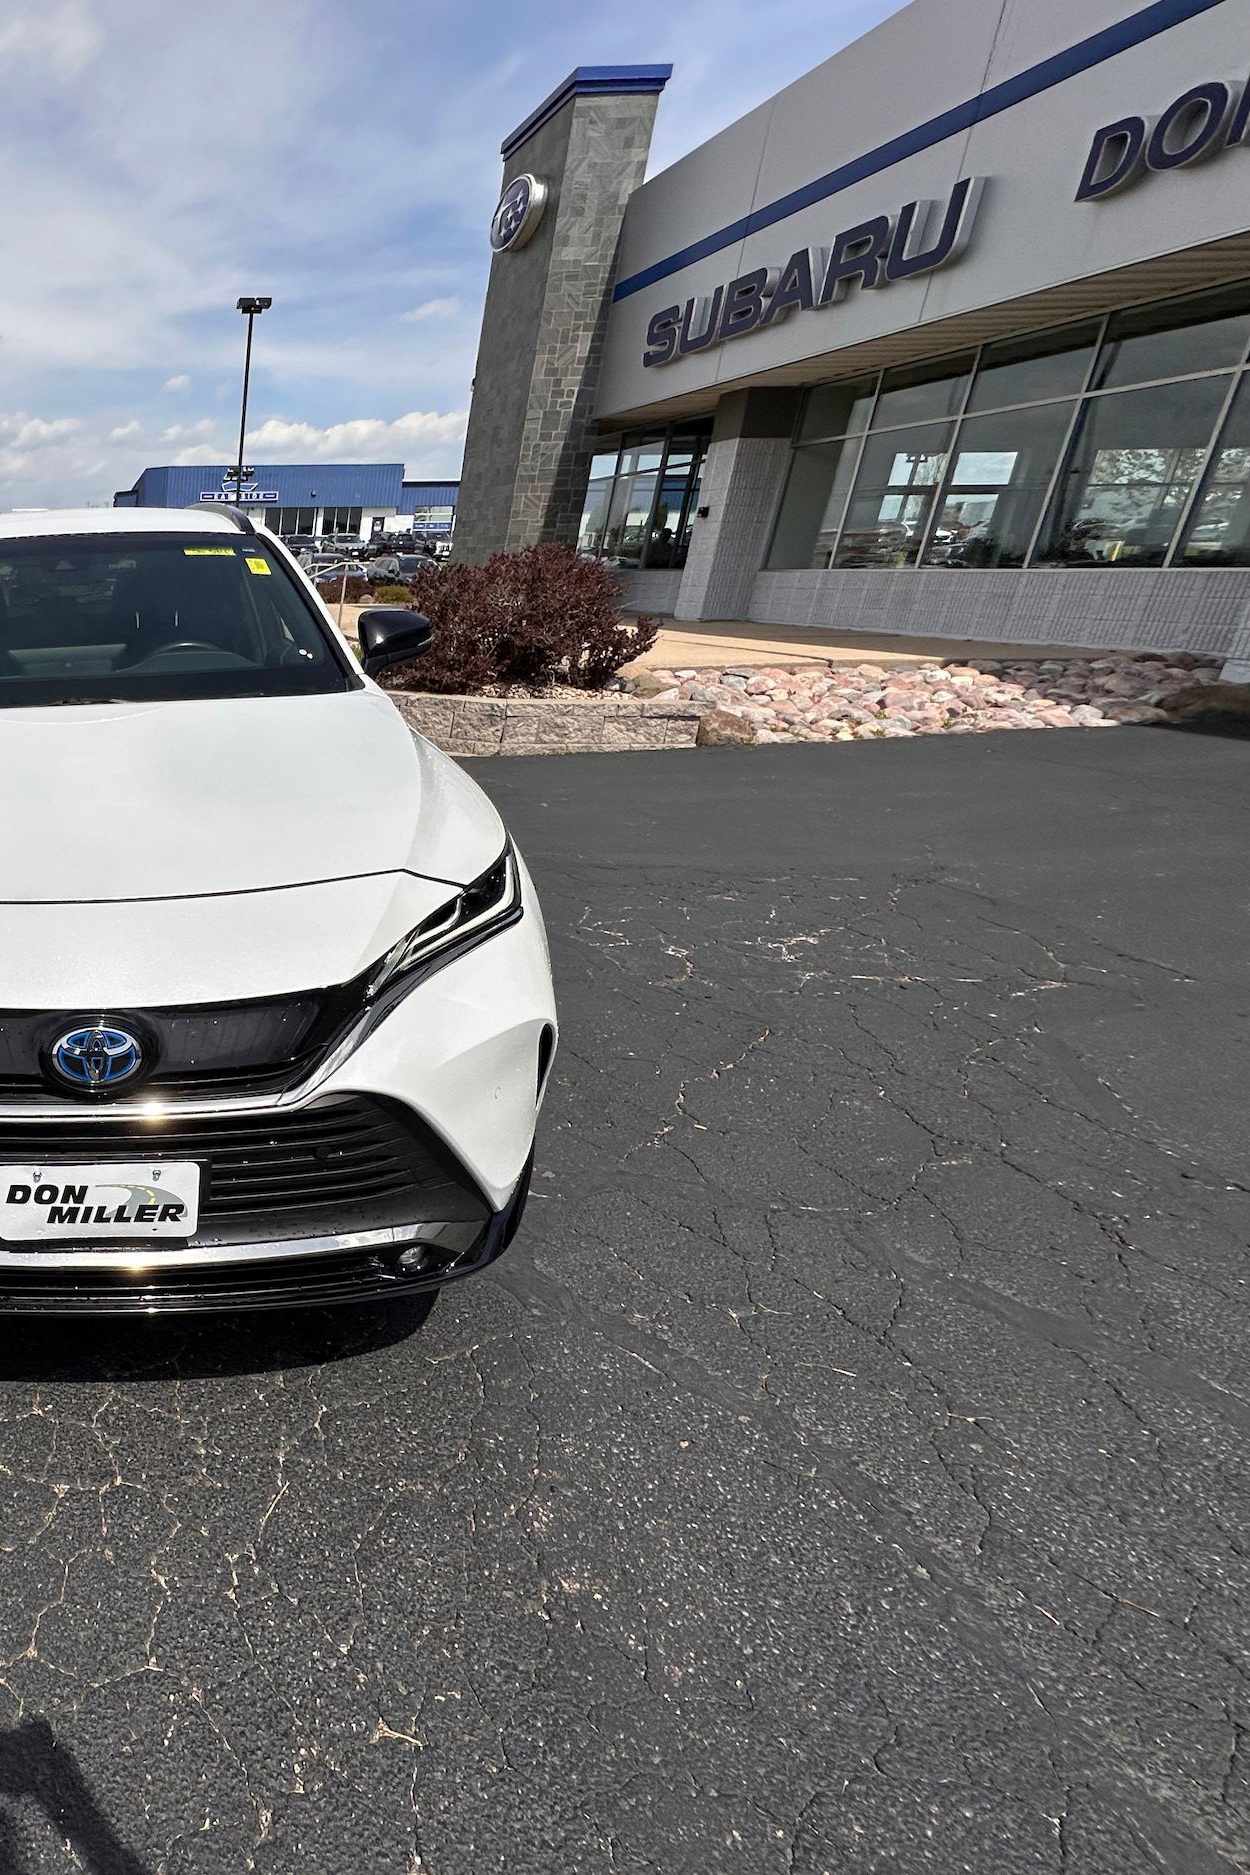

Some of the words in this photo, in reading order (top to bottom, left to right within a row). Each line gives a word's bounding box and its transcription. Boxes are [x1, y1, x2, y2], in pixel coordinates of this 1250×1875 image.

[1073, 74, 1250, 203] DO
[643, 176, 977, 369] SUBARU
[6, 1184, 88, 1204] DON
[47, 1203, 184, 1223] MILLER
